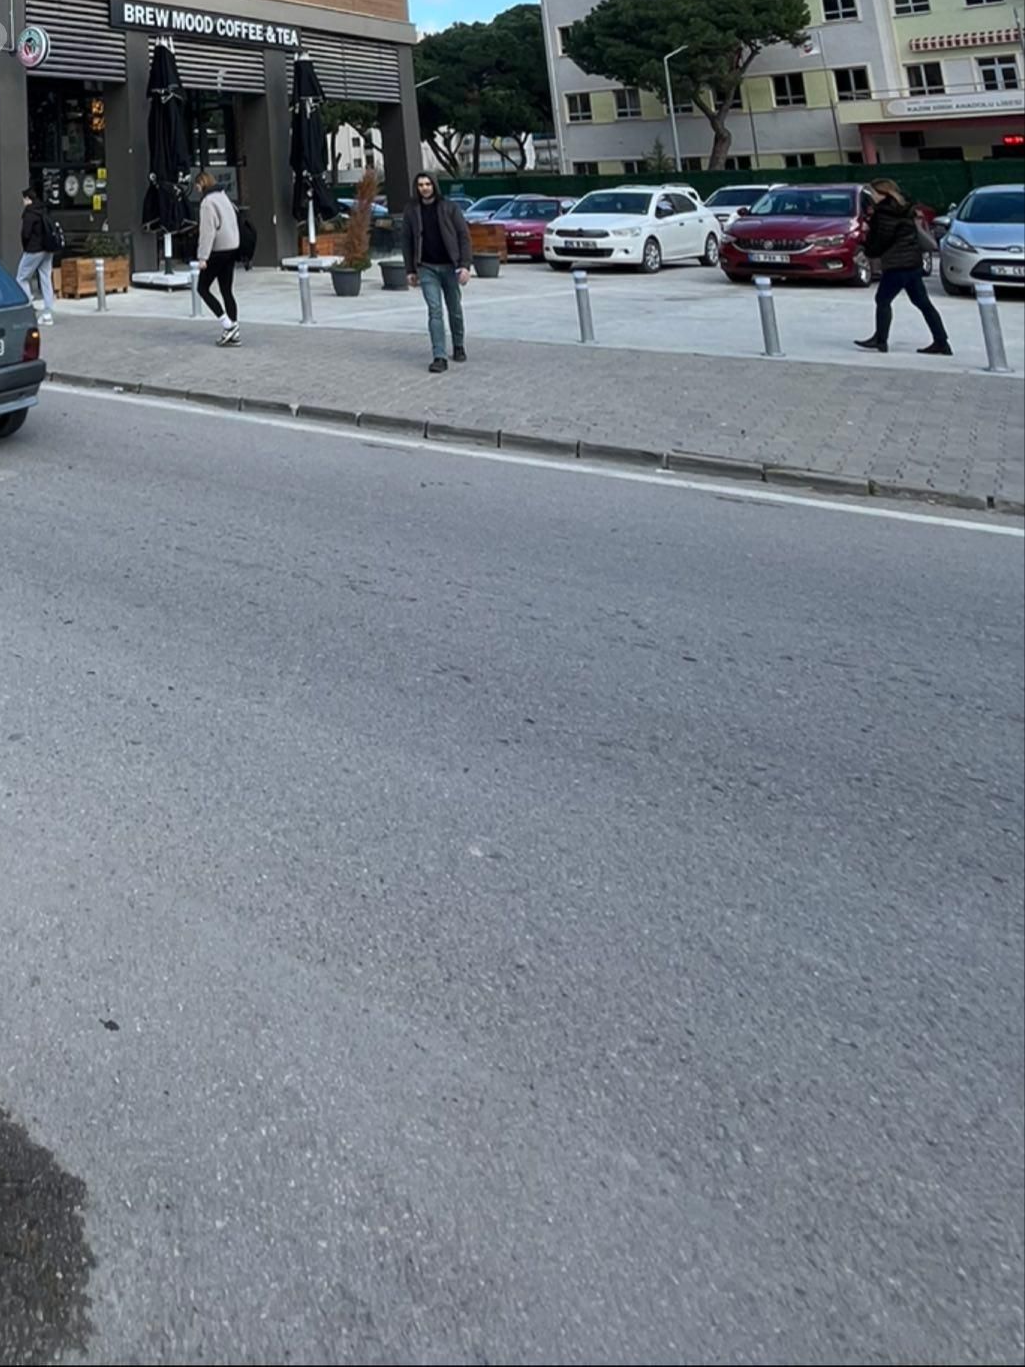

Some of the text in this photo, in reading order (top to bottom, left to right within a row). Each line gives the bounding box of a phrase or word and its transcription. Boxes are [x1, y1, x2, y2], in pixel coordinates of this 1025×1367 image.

[124, 3, 299, 47] BREW MOOD COFFEE & TEA
